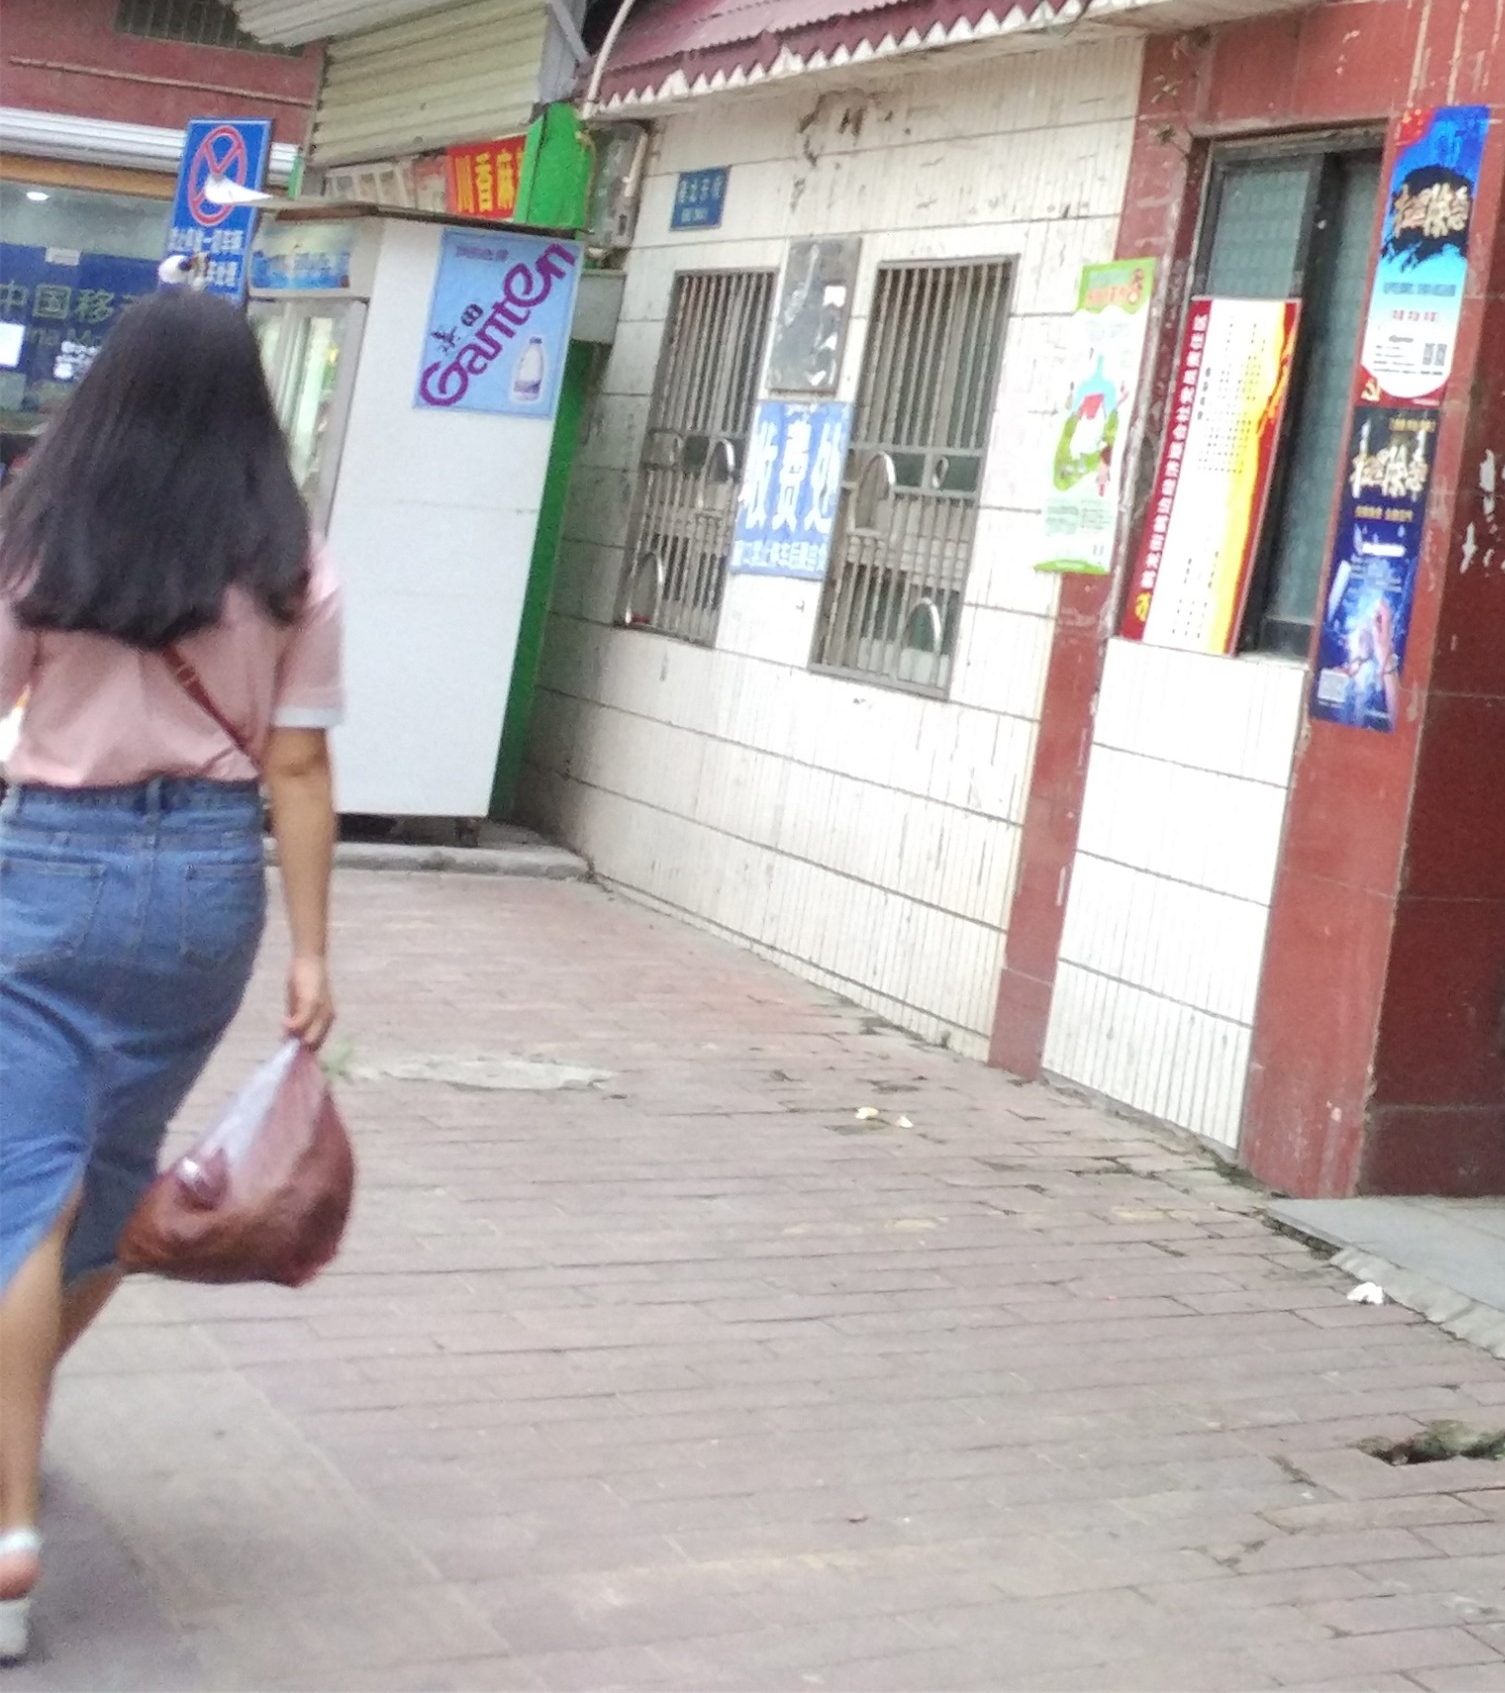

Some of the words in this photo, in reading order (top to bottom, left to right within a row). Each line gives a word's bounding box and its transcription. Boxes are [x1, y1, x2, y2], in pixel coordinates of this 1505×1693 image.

[0, 280, 134, 324] 中国移
[419, 243, 576, 406] Ganten
